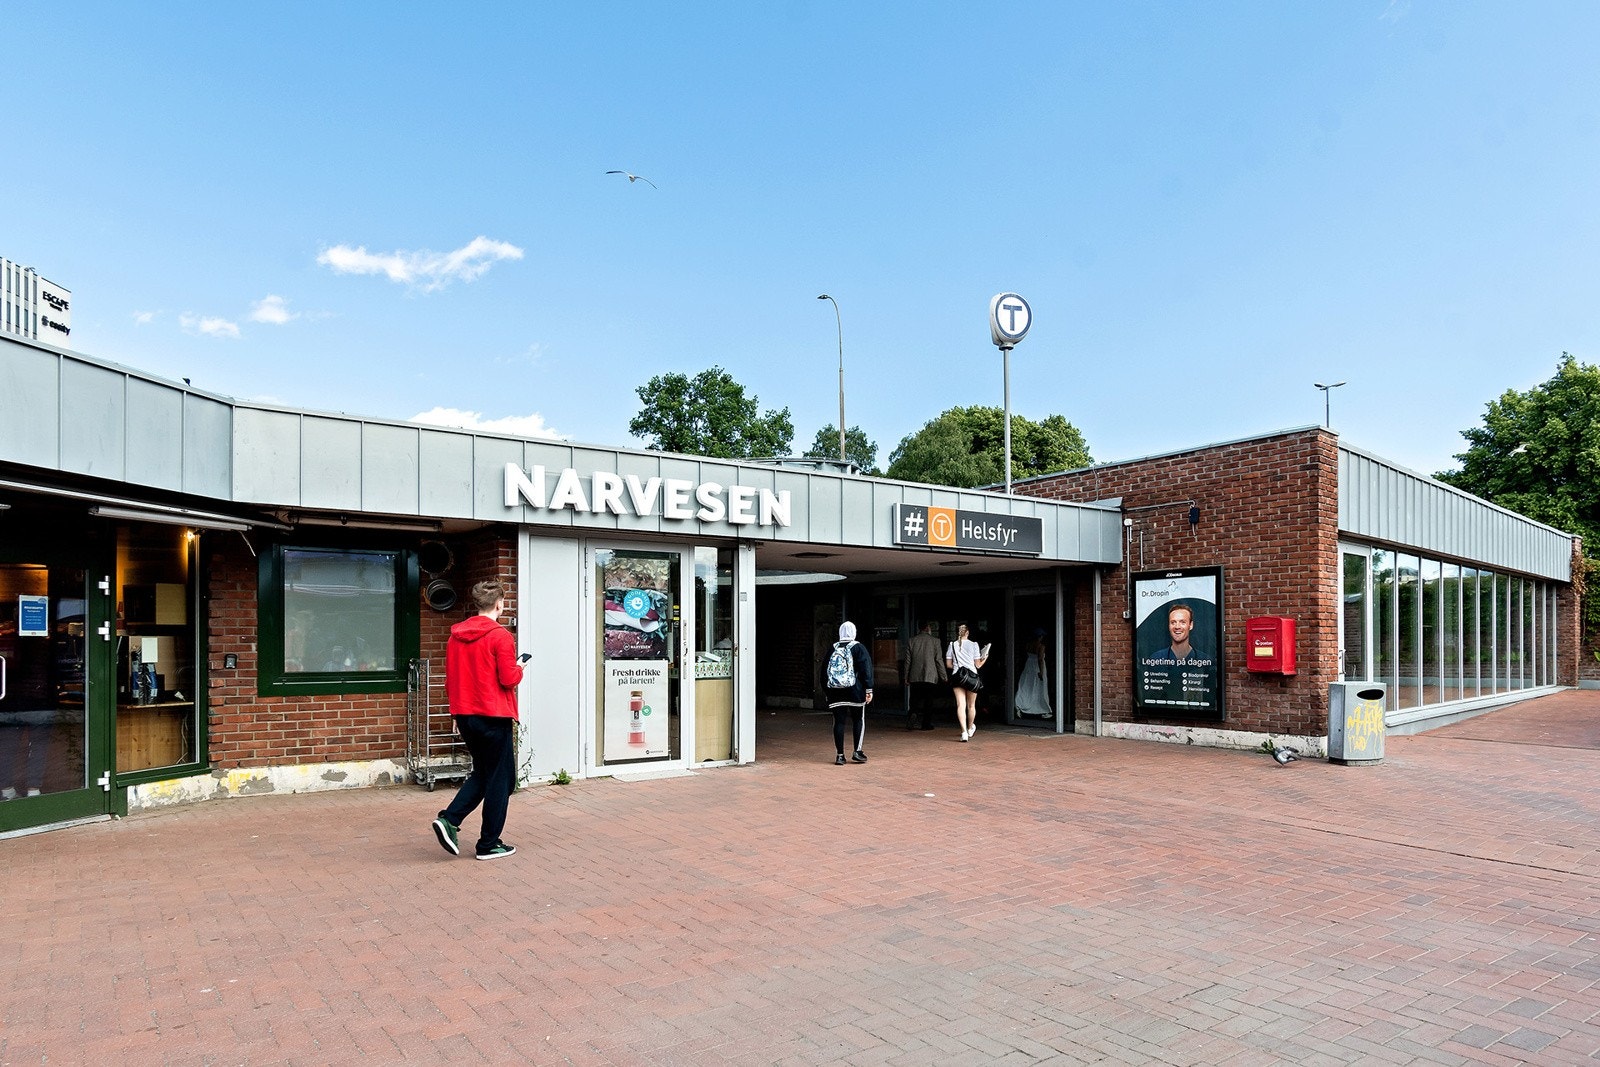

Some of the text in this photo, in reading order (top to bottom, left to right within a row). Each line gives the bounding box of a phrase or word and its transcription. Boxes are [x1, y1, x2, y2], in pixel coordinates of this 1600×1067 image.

[1003, 304, 1022, 331] T
[504, 462, 791, 527] NARVESEN
[961, 519, 1018, 546] Helsfyr
[1142, 657, 1212, 668] Legetime på dagen
[612, 668, 661, 677] Fresh drikke
[618, 677, 655, 686] på farten!
